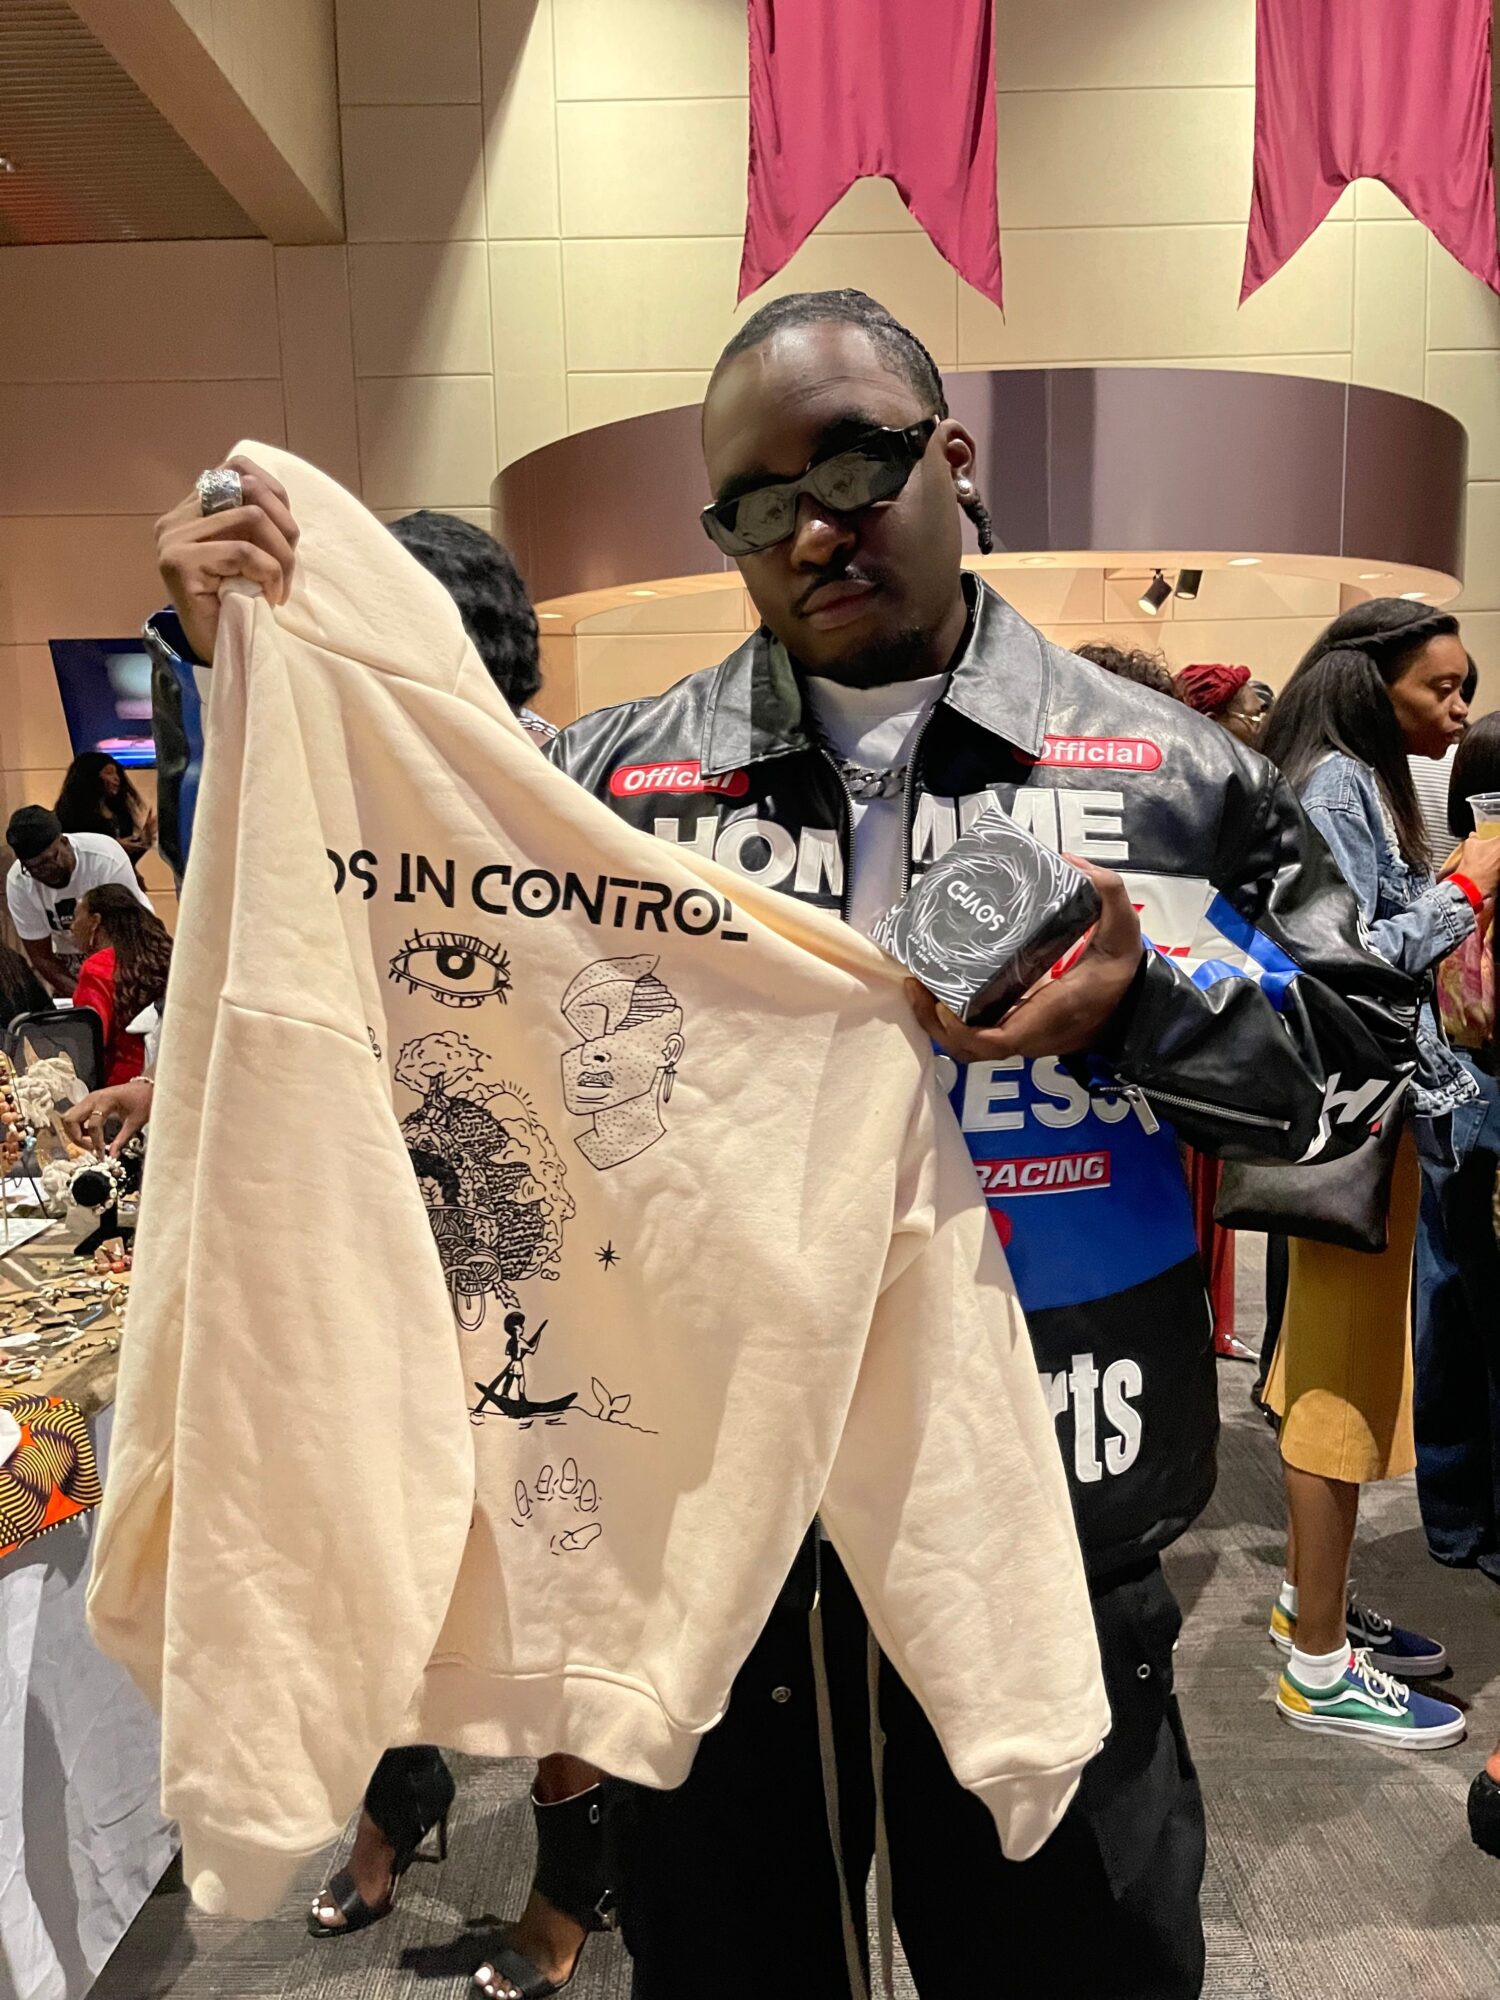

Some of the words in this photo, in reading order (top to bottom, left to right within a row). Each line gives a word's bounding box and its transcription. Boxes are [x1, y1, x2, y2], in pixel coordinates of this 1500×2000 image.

[394, 852, 455, 908] IN
[471, 864, 748, 942] CONTROL
[946, 880, 1006, 932] CHAOS
